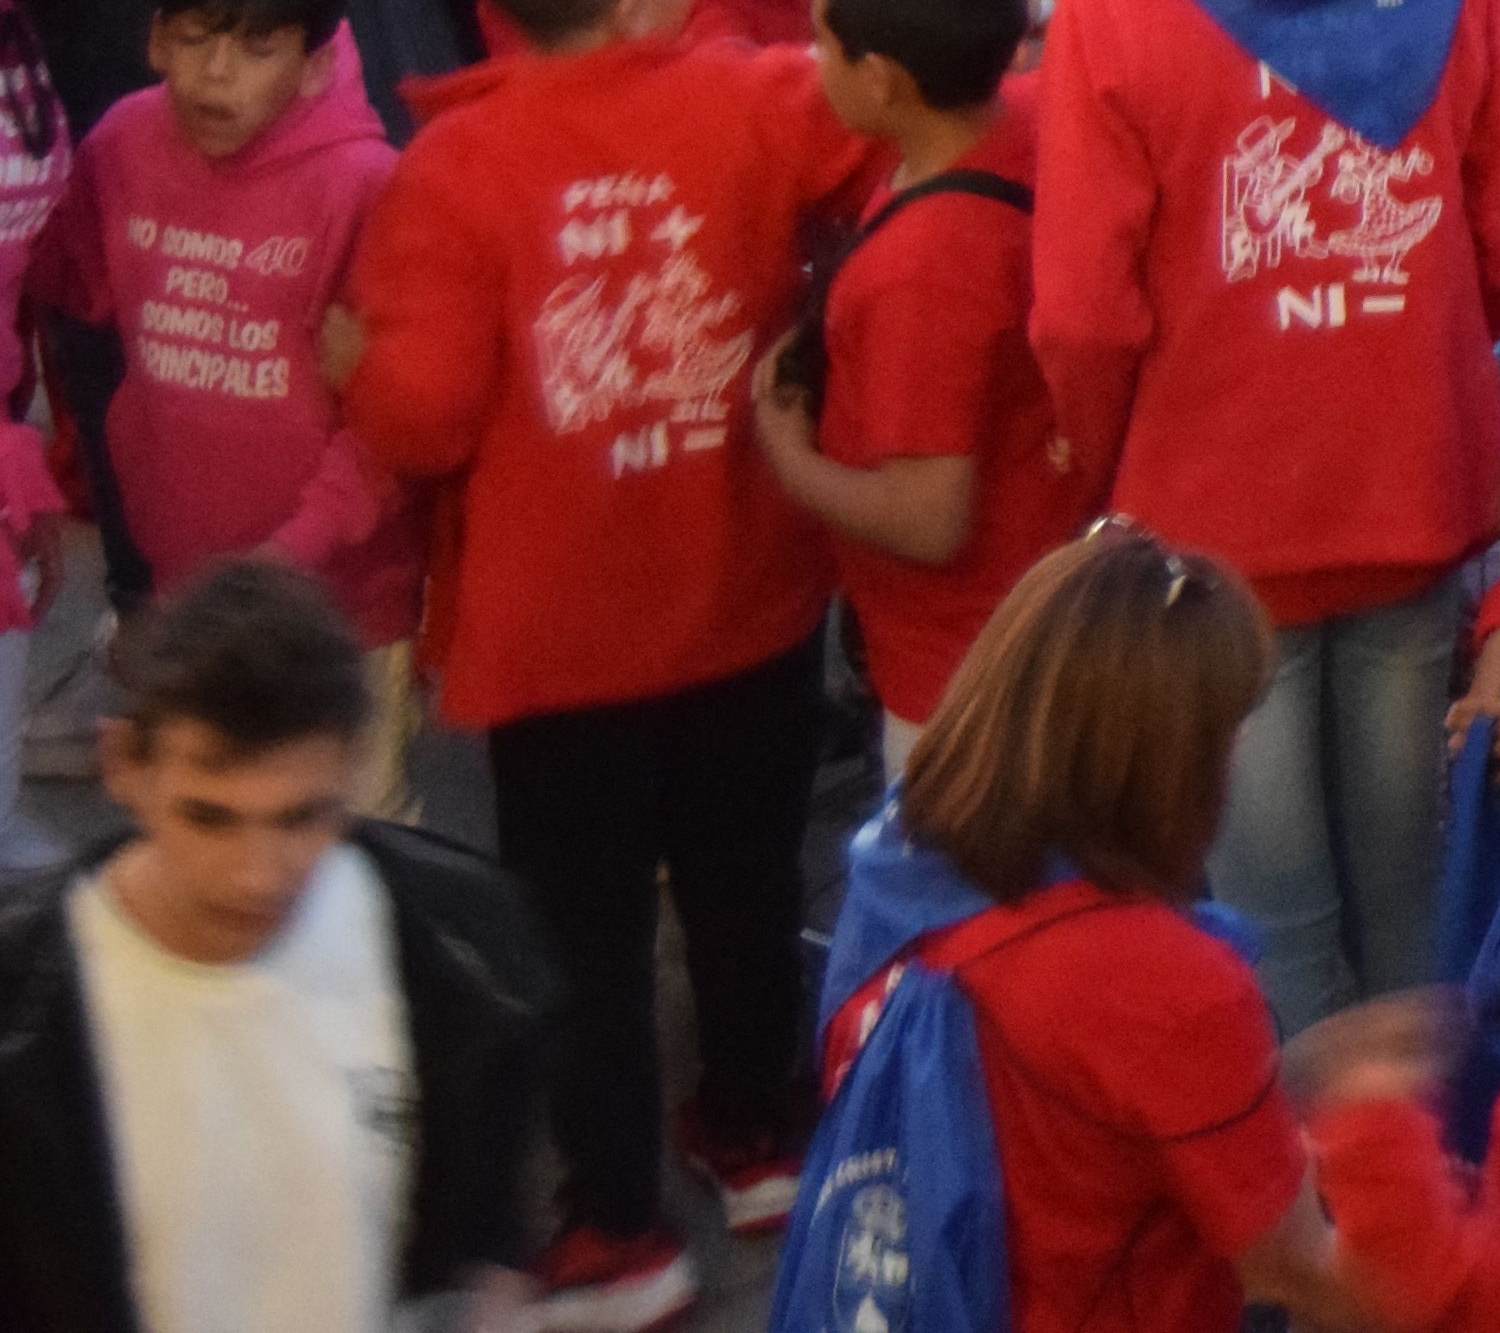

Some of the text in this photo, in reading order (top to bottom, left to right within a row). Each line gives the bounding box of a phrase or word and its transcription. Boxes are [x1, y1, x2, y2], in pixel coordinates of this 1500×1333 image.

[162, 225, 243, 270] SOMOS
[141, 299, 280, 352] SOMOS LOS
[1276, 282, 1346, 329] NI
